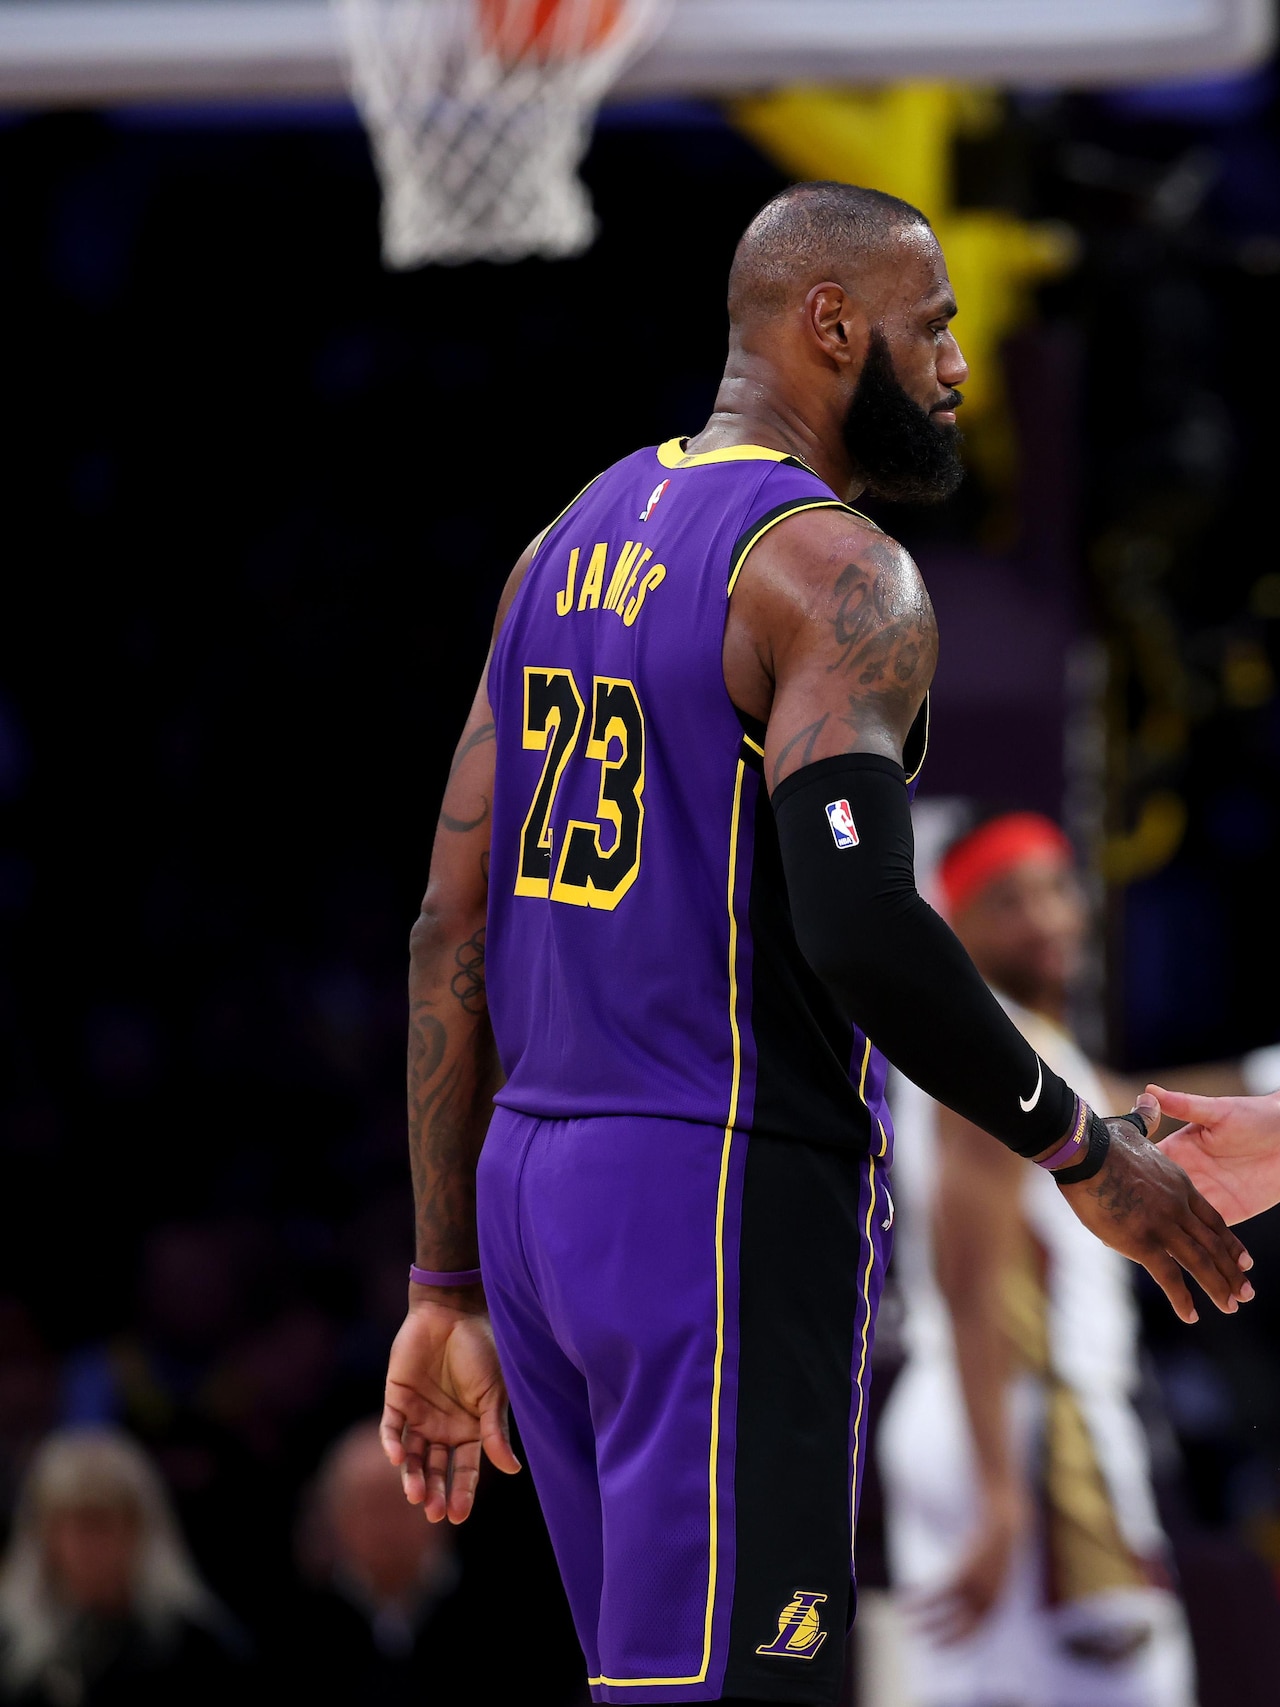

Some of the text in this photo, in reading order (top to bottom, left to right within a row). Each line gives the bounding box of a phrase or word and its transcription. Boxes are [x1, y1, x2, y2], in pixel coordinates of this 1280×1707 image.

[556, 540, 667, 627] JAMES
[514, 666, 646, 911] 23
[838, 837, 853, 847] NBA
